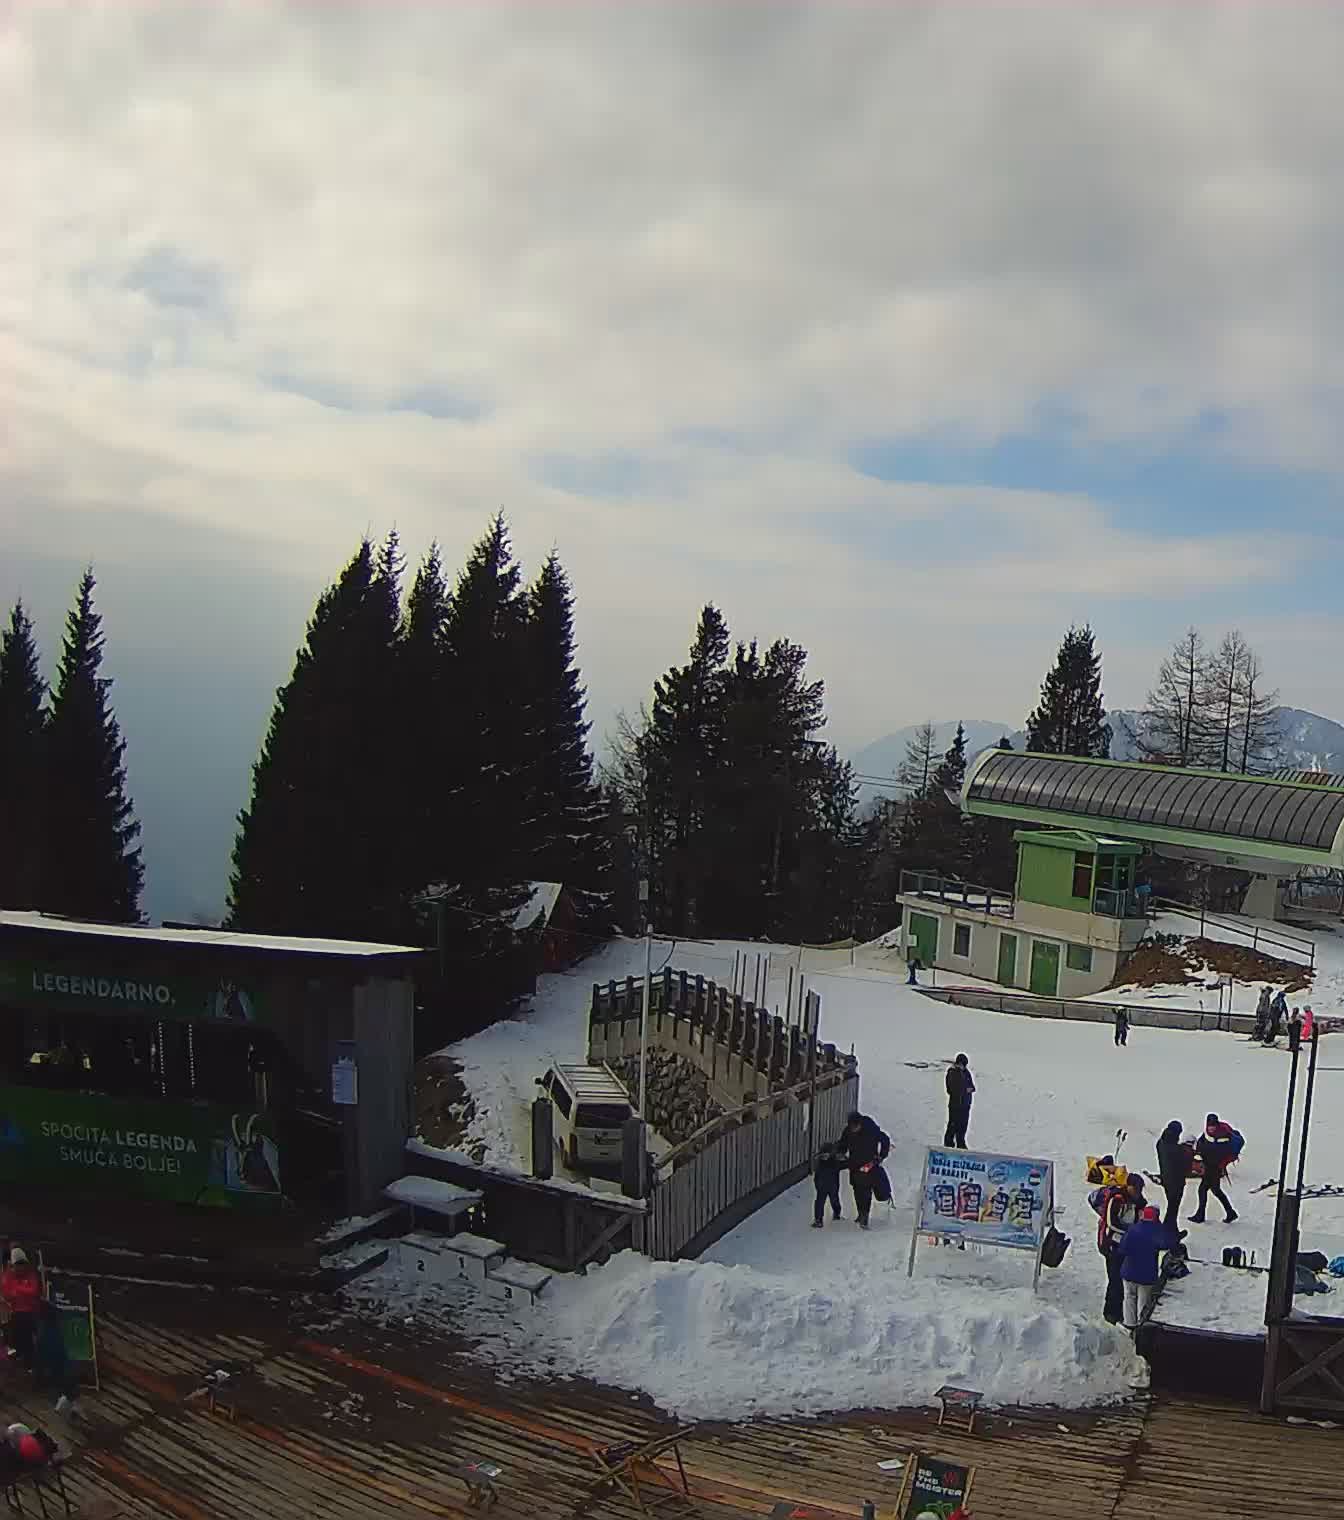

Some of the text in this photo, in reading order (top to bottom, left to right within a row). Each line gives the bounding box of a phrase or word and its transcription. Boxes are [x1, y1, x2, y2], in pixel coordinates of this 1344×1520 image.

[116, 1130, 198, 1153] LEGENDA
[417, 1260, 425, 1272] 2
[458, 1256, 465, 1269] 1
[504, 1286, 513, 1299] 3
[915, 1480, 962, 1496] MEISTER
